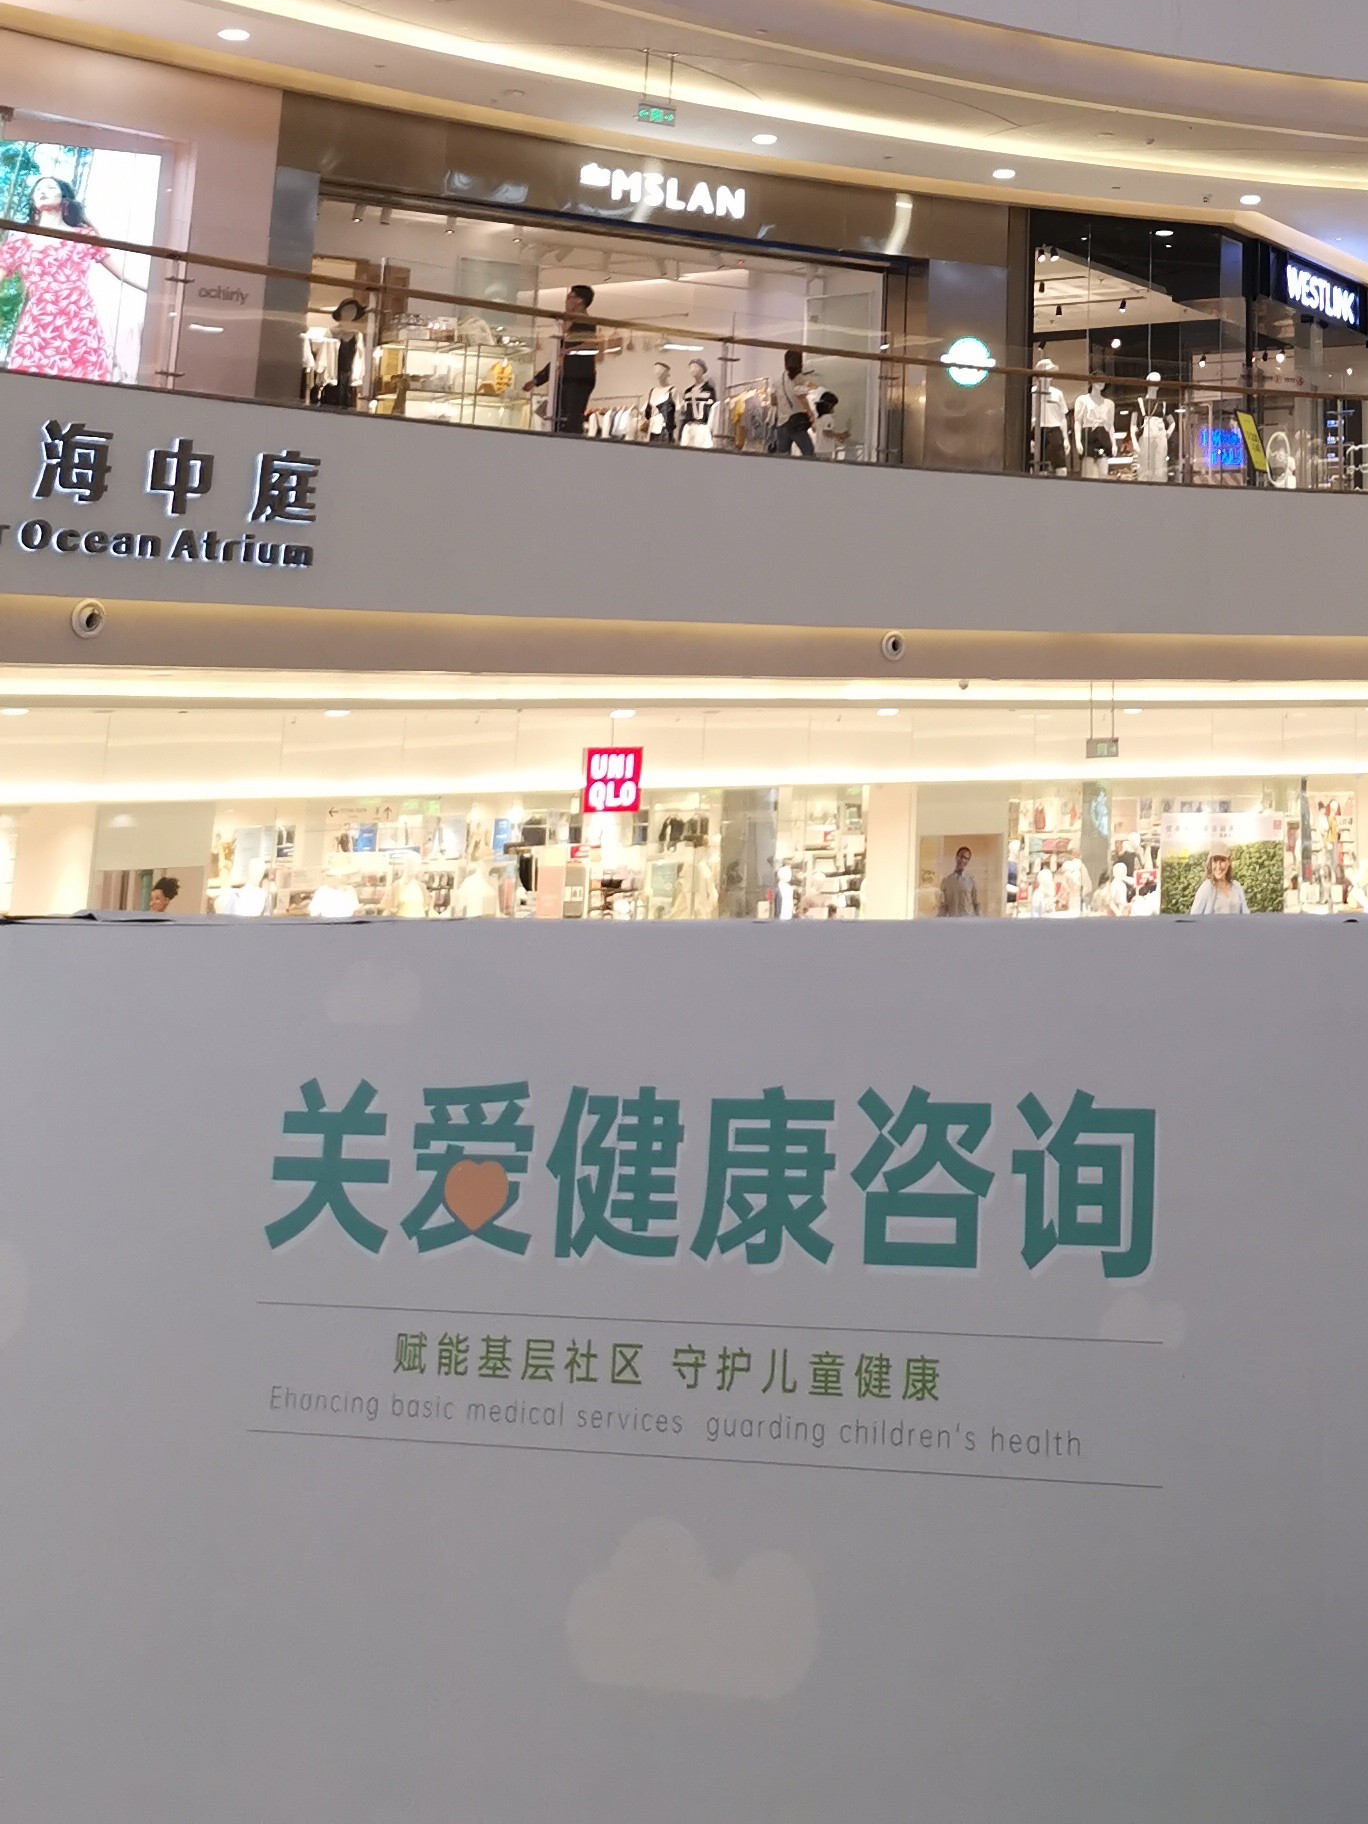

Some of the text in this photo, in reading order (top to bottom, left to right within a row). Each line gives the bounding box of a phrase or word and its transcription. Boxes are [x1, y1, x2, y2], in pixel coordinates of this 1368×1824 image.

[1286, 264, 1355, 325] WESTLINK
[17, 518, 162, 560] Ocean
[168, 528, 315, 569] Atrium
[588, 780, 637, 811] QLO
[590, 753, 635, 780] UNI
[262, 1076, 1160, 1282] 关爱健康咨询
[392, 1330, 942, 1404] 赋能基层社区 守护儿童健康
[268, 1383, 1084, 1459] Ehancing basic medical services guarding children's health
